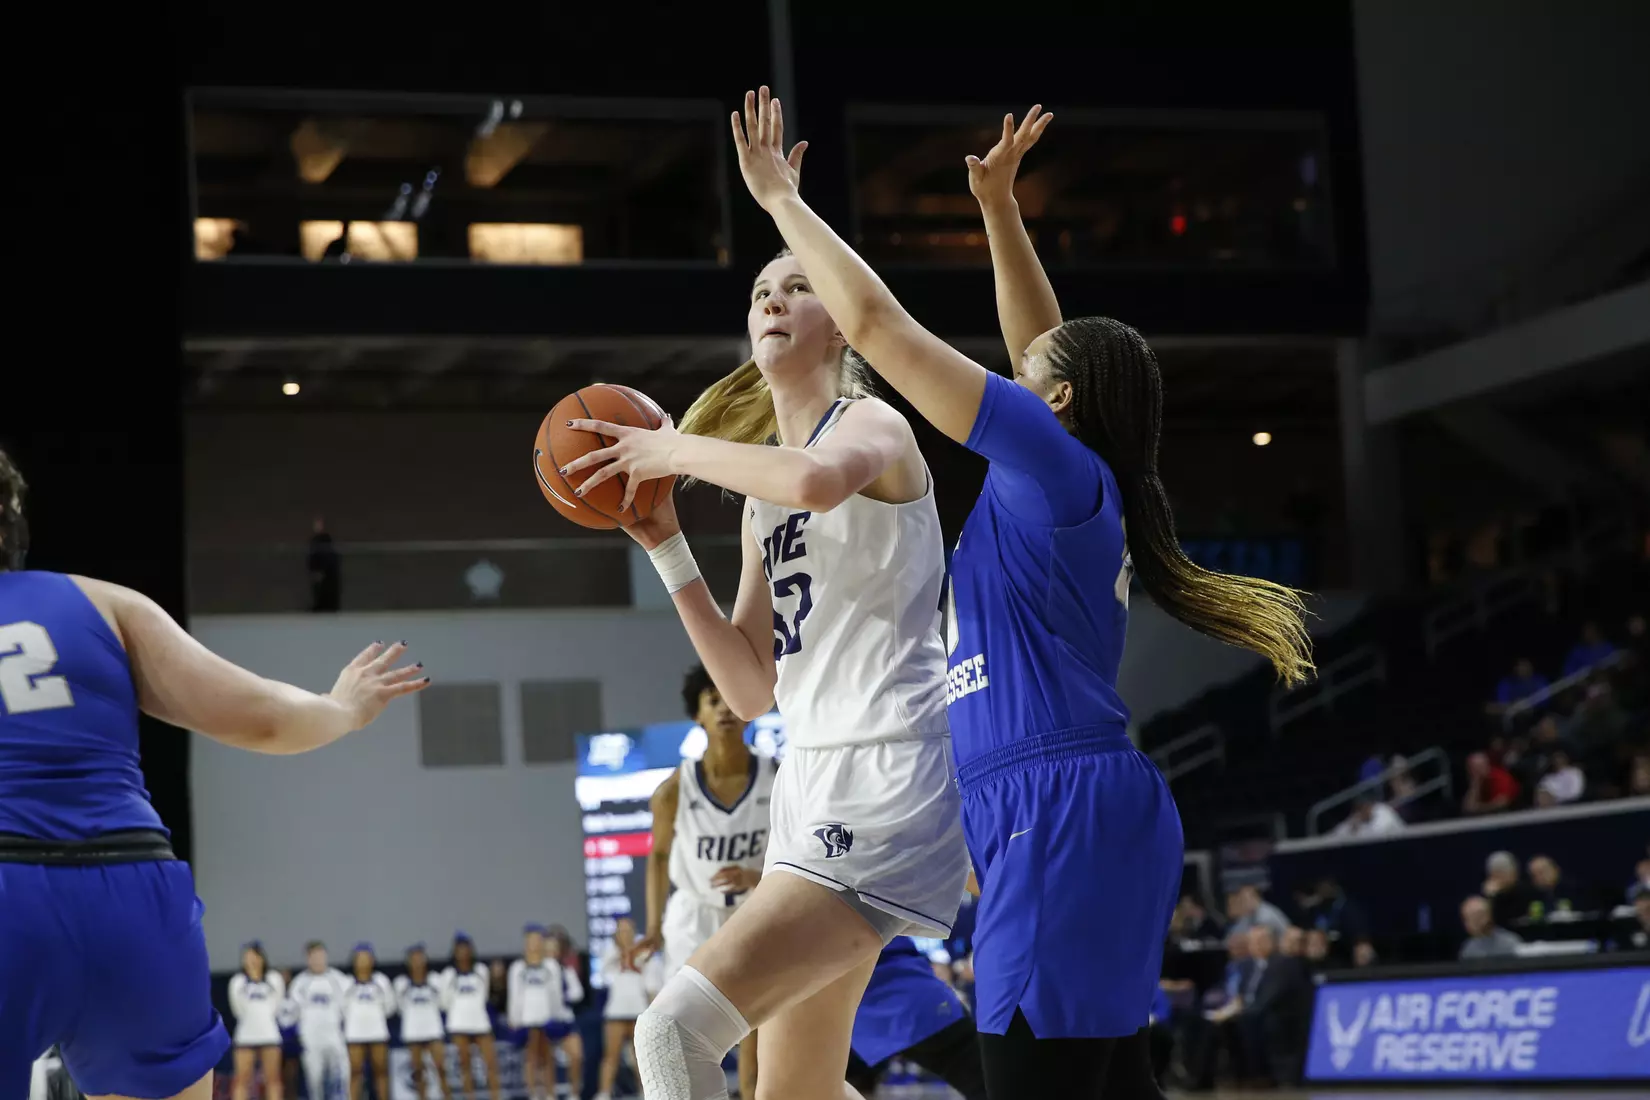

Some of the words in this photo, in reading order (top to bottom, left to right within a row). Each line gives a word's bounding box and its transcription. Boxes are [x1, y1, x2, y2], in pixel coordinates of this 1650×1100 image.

[773, 572, 813, 661] 2
[946, 653, 989, 706] SSEE
[697, 829, 767, 861] RICE
[1369, 993, 1431, 1031] AIR
[1434, 987, 1558, 1028] FORCE
[1372, 1030, 1541, 1072] RESERVE
